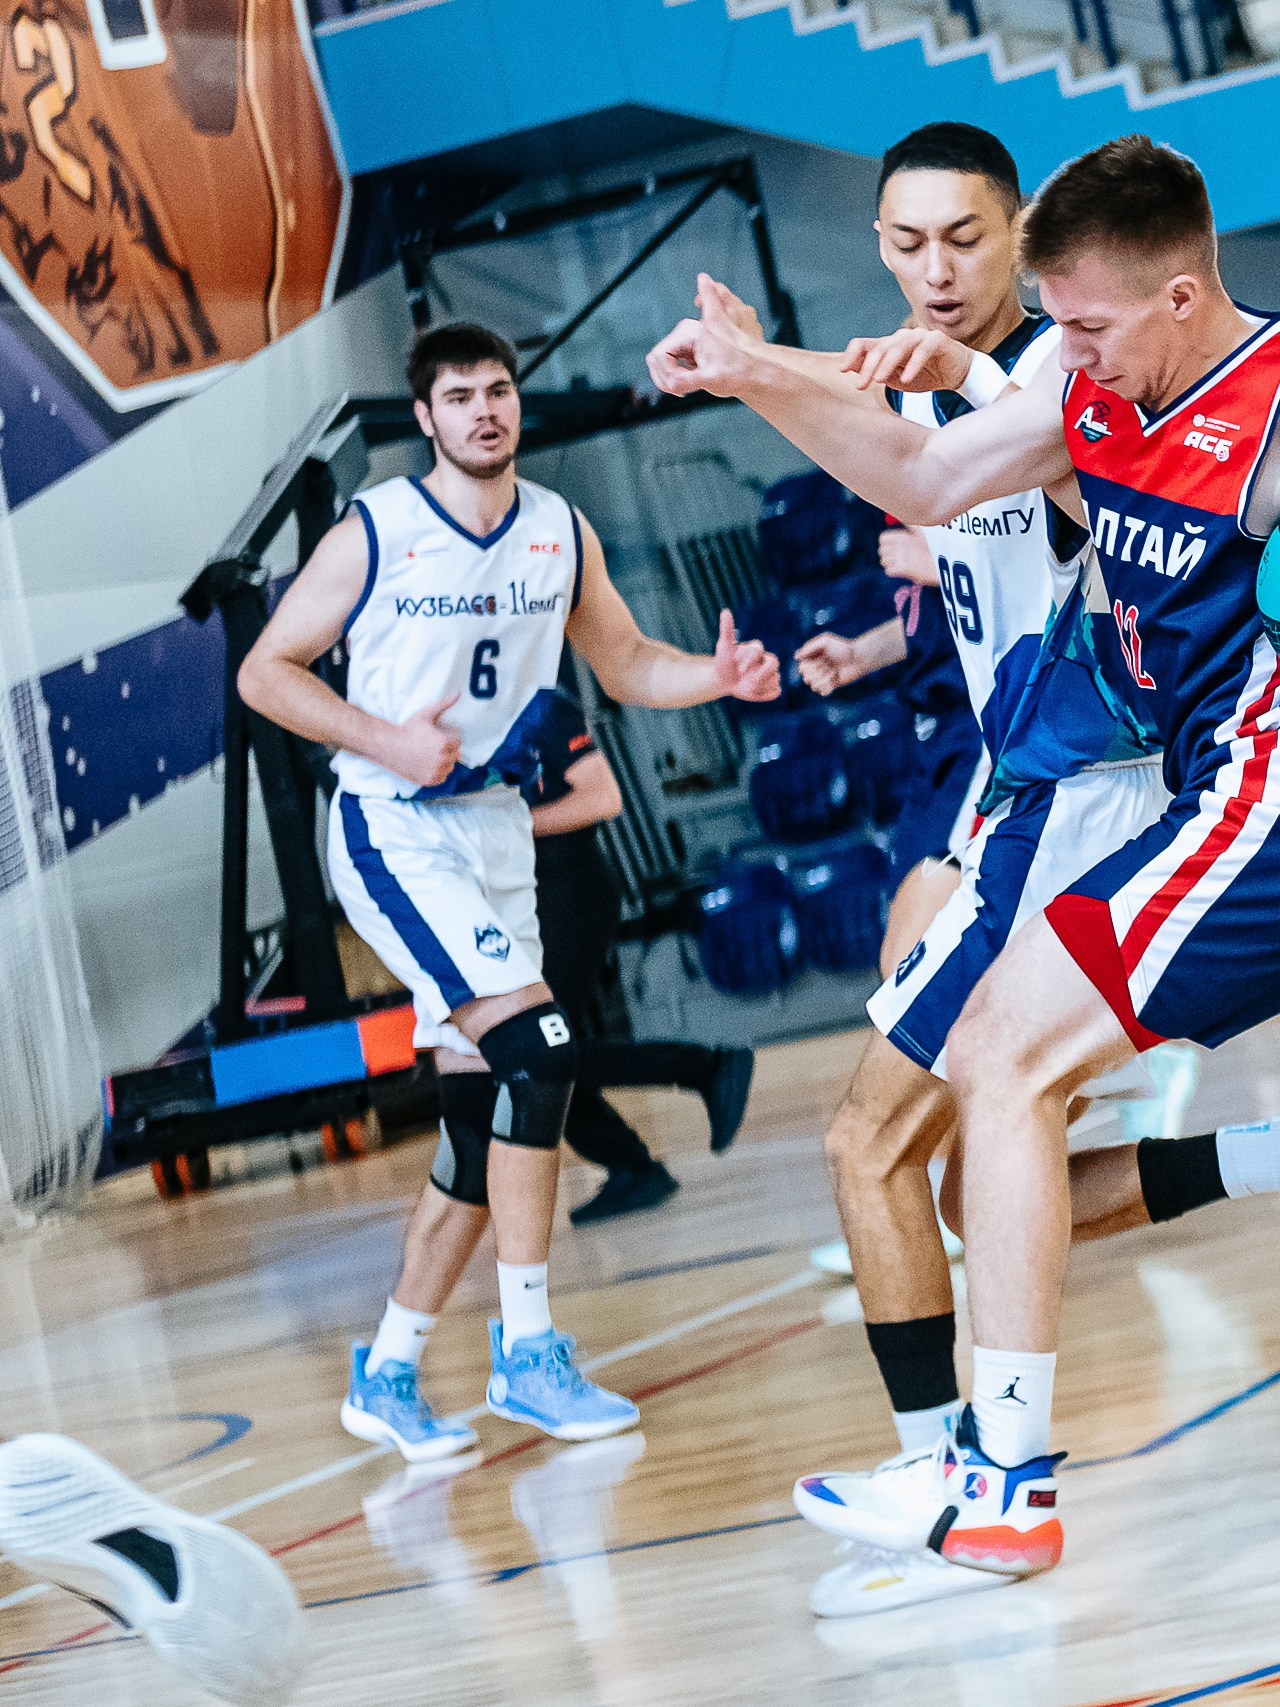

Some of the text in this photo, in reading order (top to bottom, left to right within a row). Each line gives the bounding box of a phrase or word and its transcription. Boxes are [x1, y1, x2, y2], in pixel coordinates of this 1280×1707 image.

[1081, 499, 1207, 580] ЛТАЙ
[938, 554, 984, 645] 99
[469, 638, 500, 700] 6
